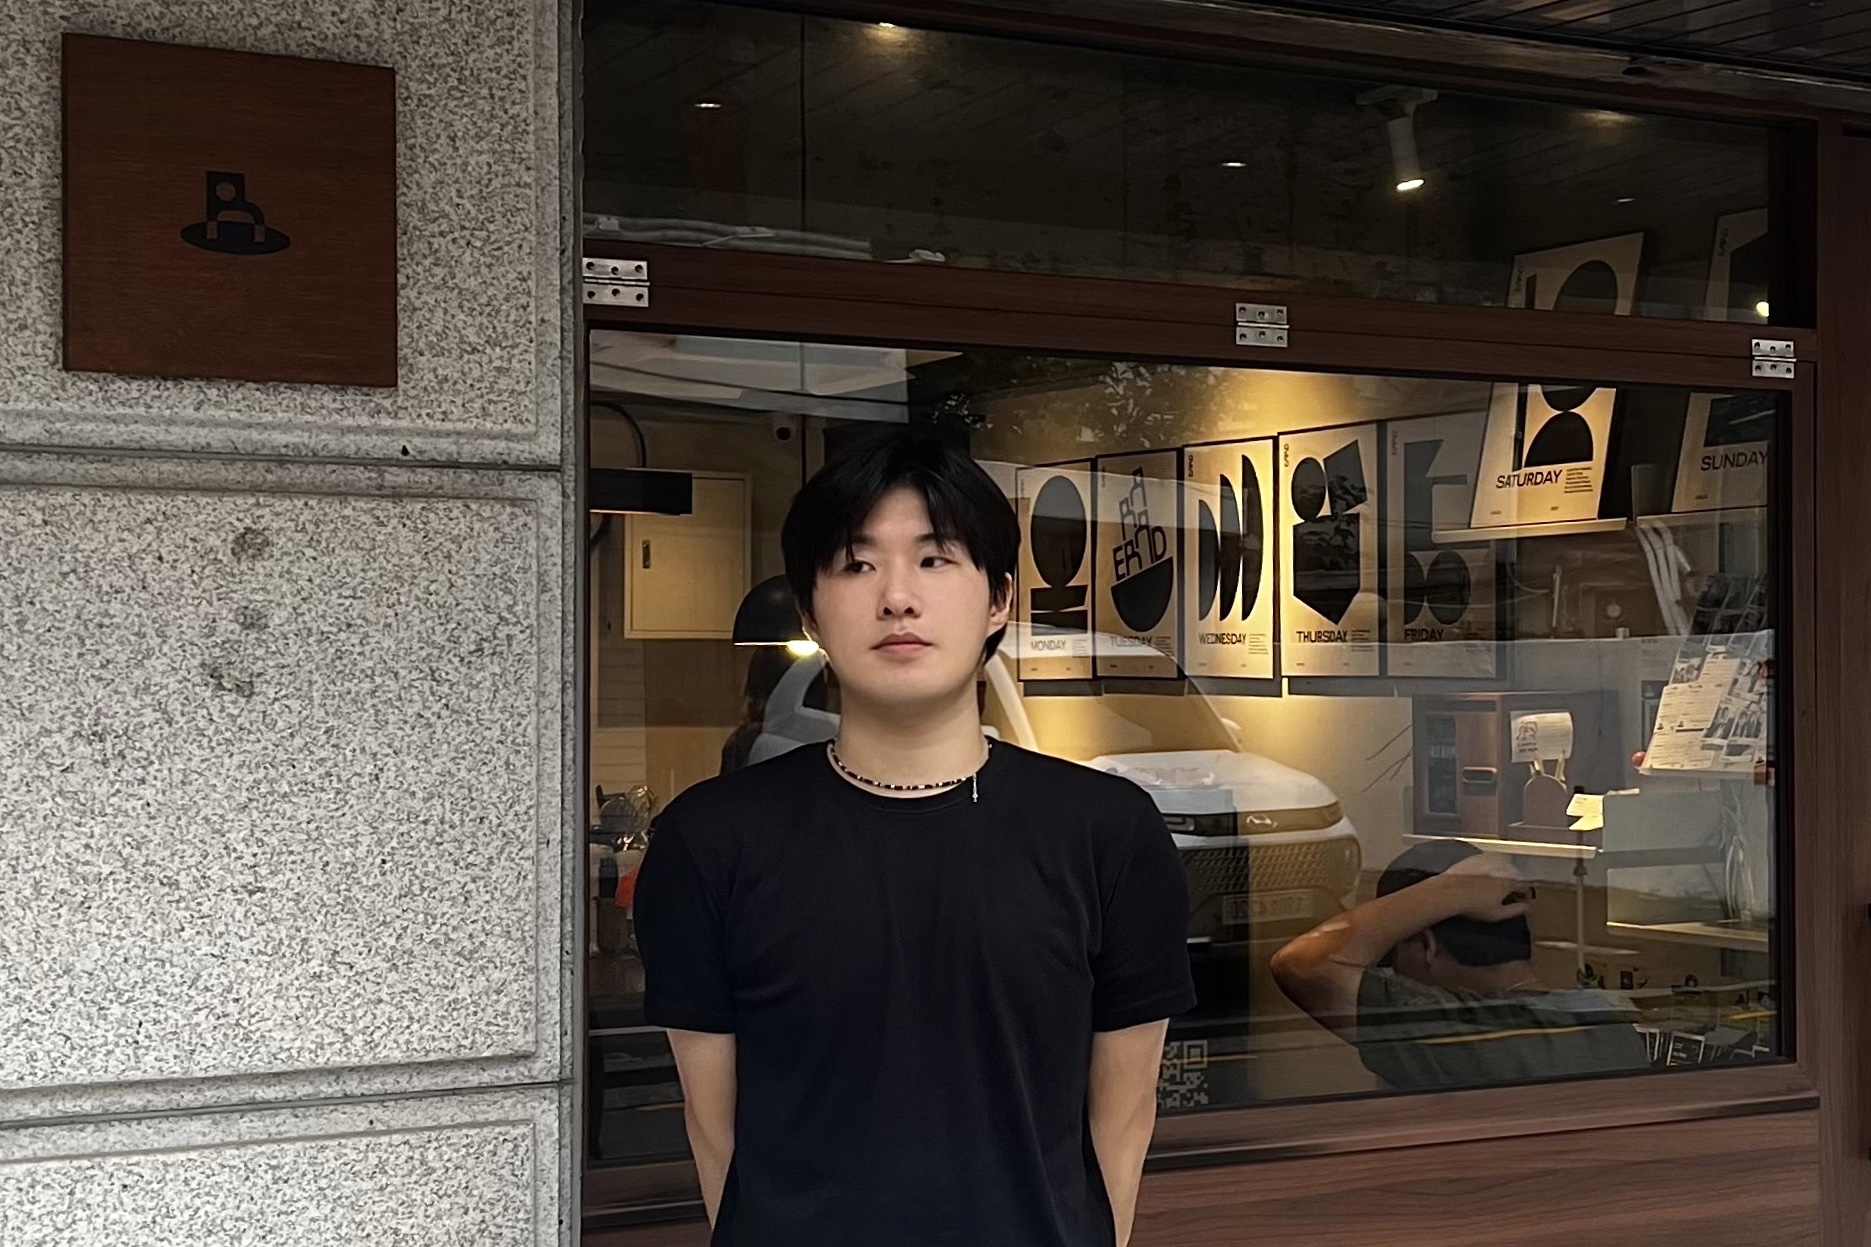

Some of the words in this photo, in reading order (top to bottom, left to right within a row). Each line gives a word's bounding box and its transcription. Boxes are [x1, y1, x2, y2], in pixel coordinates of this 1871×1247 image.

[1700, 450, 1768, 472] SUNDAY
[1496, 469, 1563, 489] SATURDAY
[1198, 632, 1247, 645] WEDNESDAY
[1296, 630, 1348, 643] THURSDAY
[1404, 628, 1444, 642] FRIDAY
[1030, 639, 1067, 651] MONDAY
[1110, 636, 1152, 648] TUESDAY
